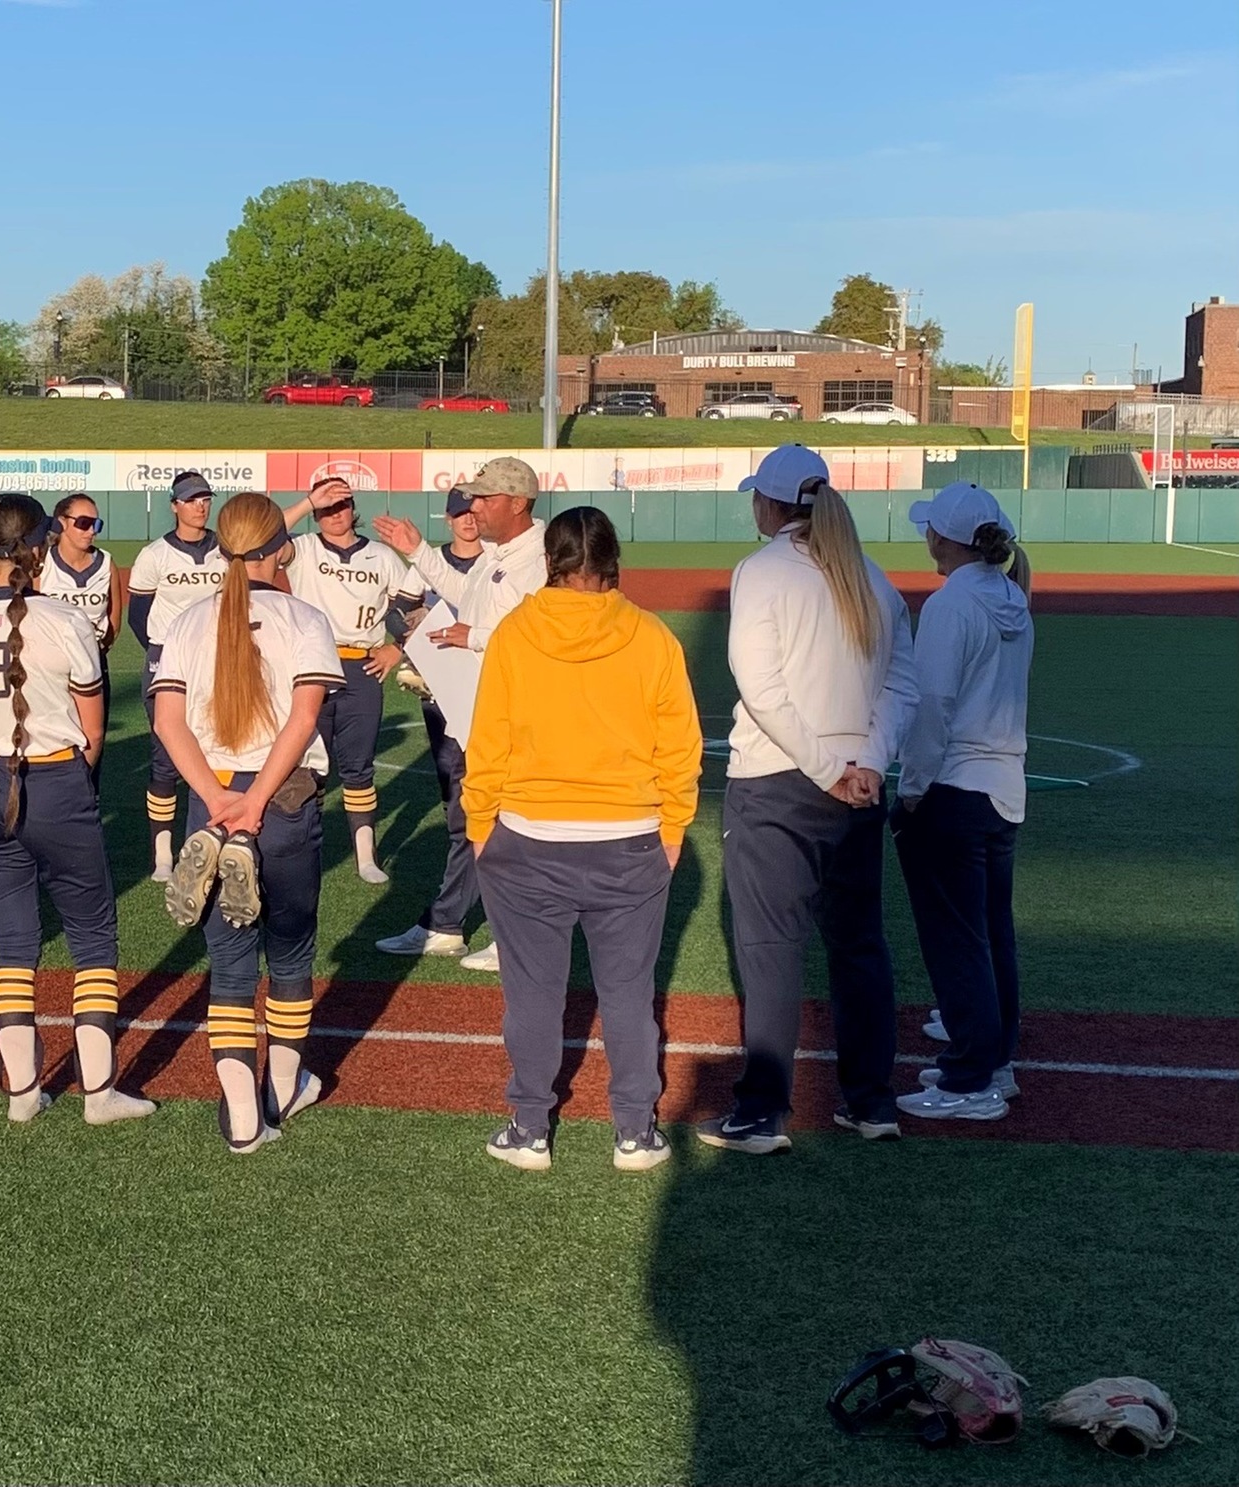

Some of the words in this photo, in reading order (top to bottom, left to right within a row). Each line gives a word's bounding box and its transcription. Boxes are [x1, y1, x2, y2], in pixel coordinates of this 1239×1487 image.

[683, 356, 718, 368] DURTY
[719, 356, 745, 367] BULL
[747, 355, 796, 367] BREWING
[40, 458, 90, 475] Roofing
[318, 562, 379, 585] GASTON
[355, 604, 376, 629] 18
